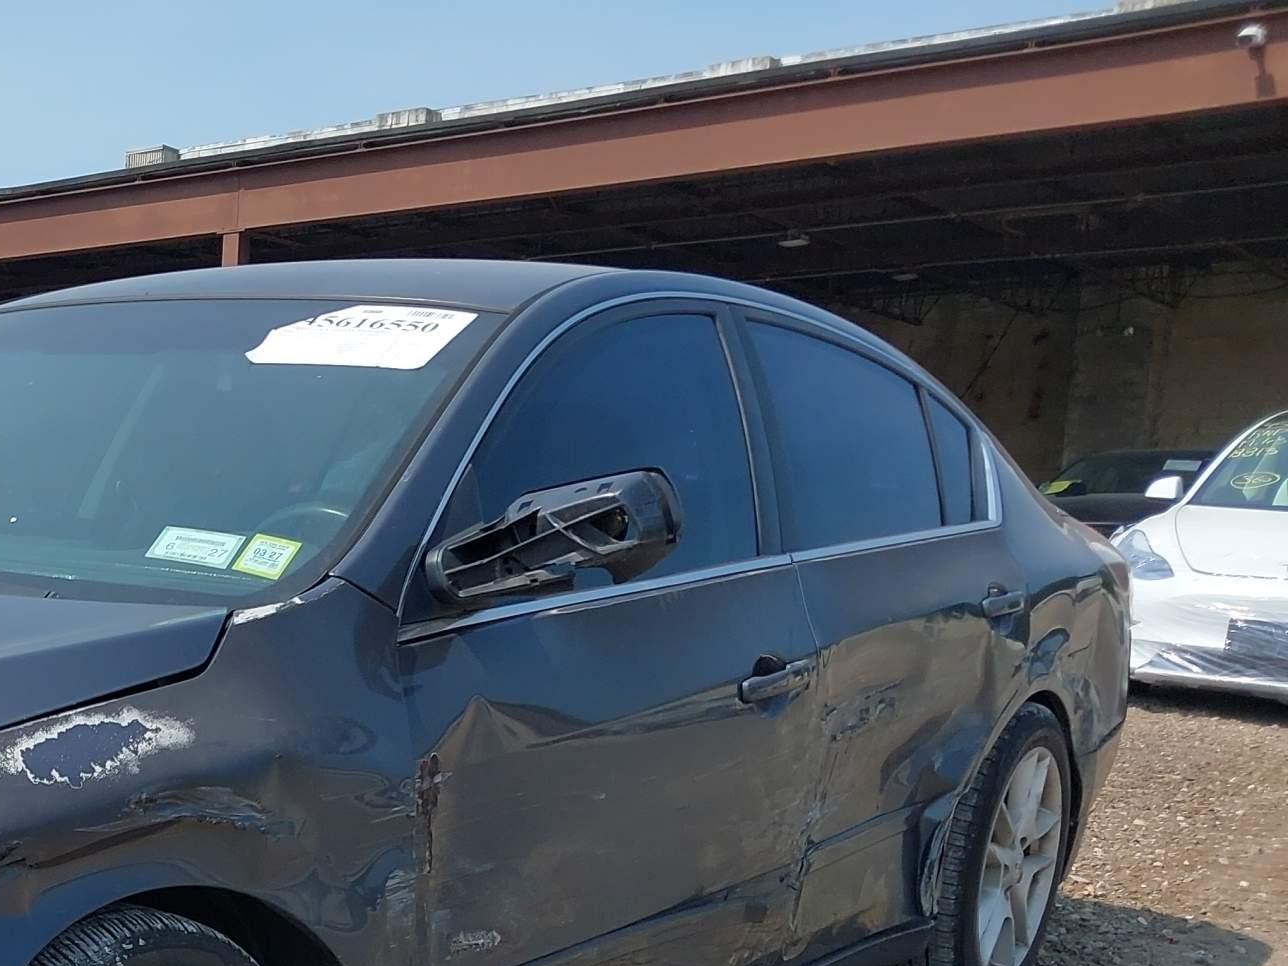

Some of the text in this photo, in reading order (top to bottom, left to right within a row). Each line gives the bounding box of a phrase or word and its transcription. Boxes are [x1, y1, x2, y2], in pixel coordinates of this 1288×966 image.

[207, 548, 228, 558] 27
[253, 547, 284, 561] 03 27
